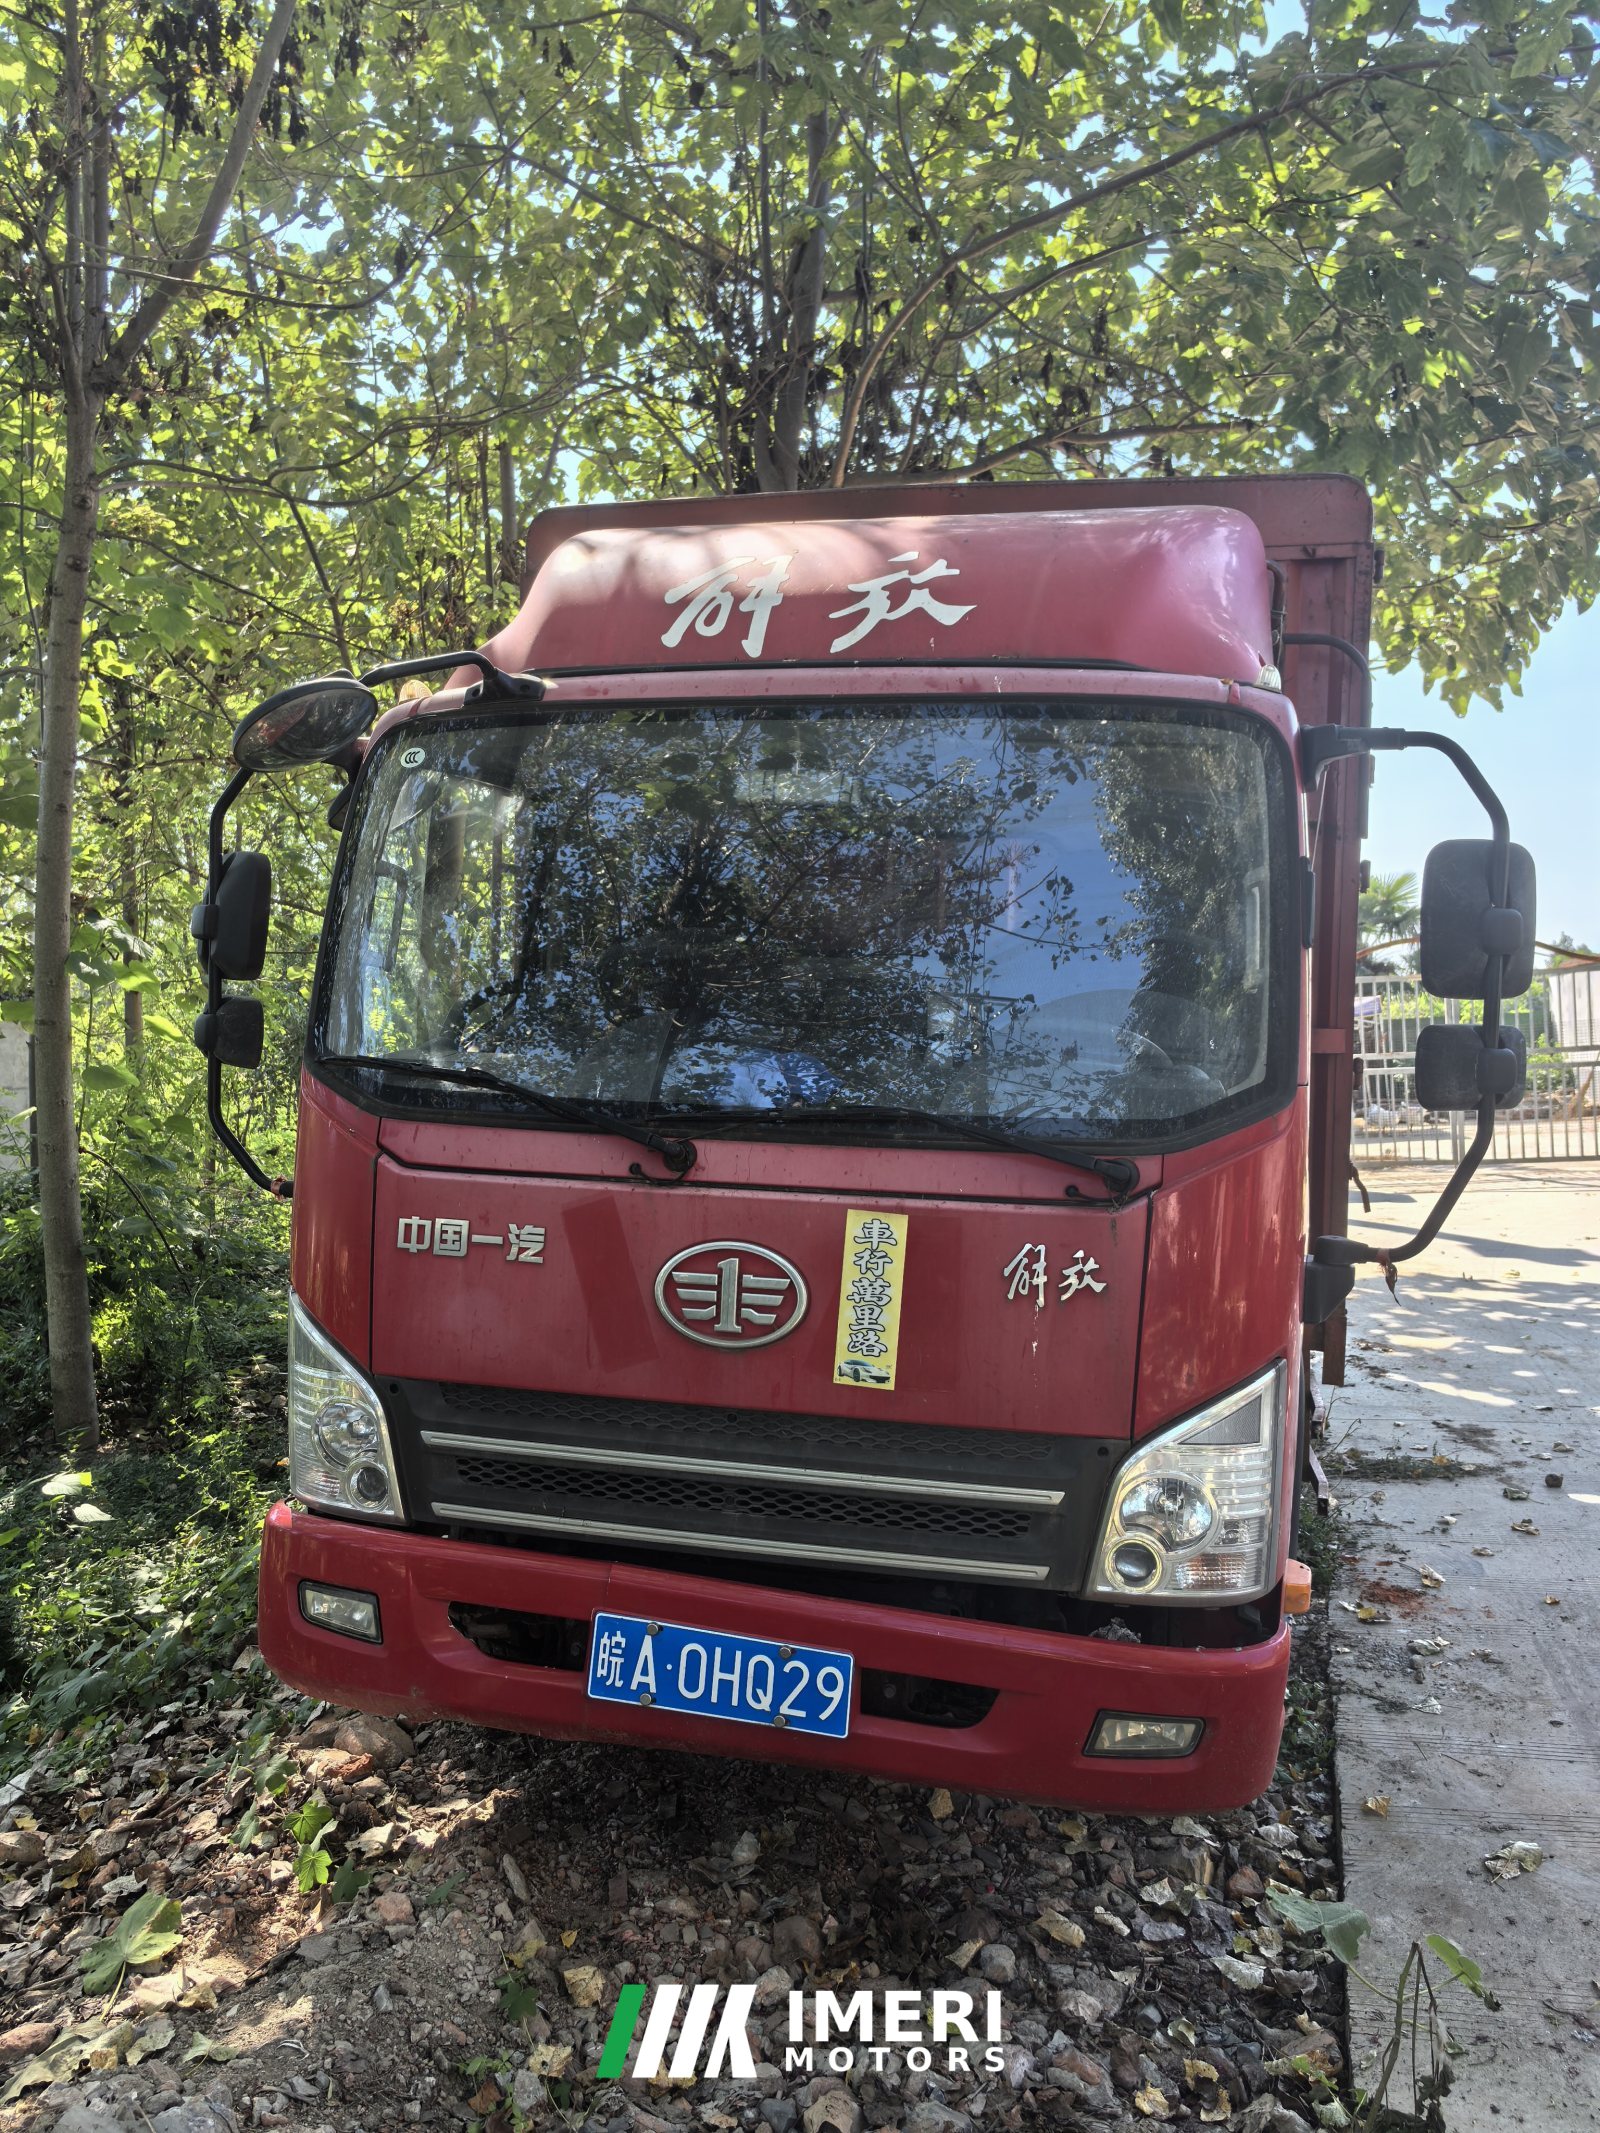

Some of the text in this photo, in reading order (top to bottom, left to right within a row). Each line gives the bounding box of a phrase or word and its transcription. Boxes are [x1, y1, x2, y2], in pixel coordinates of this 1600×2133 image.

[661, 551, 977, 658] 解放
[397, 1215, 545, 1264] 中国一汽
[1003, 1242, 1107, 1308] 解放
[847, 1218, 898, 1358] 車行萬里路
